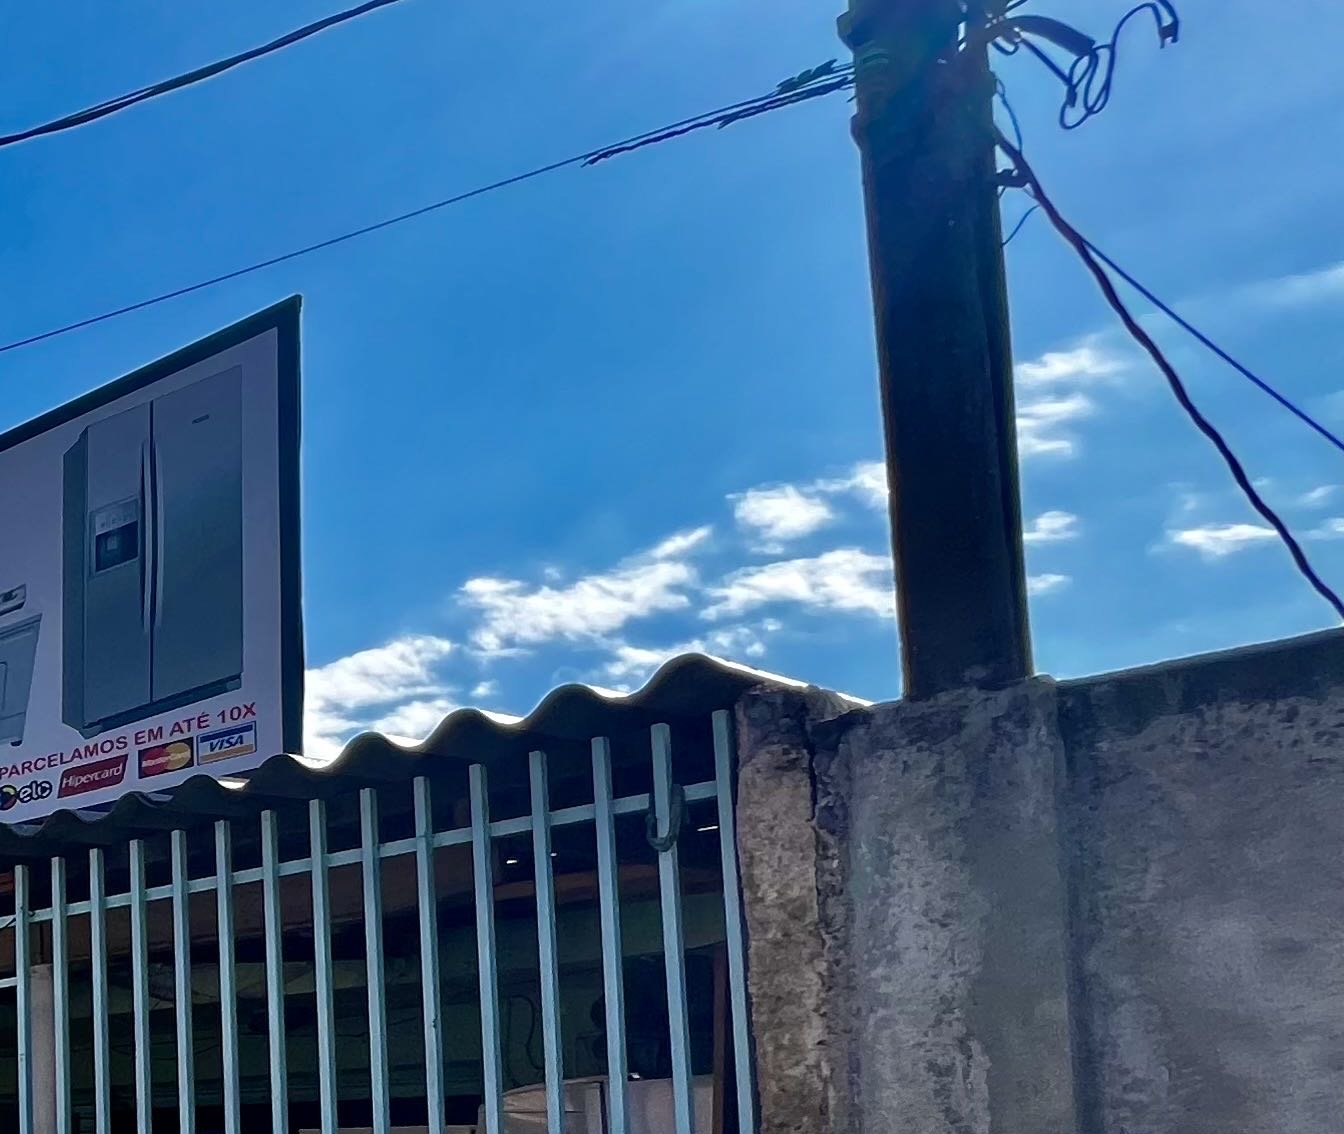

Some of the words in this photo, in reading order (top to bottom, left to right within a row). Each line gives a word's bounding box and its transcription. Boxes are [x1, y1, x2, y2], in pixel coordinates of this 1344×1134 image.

[134, 727, 163, 746] EM
[169, 712, 210, 737] ATÉ
[217, 702, 256, 724] 10X
[62, 763, 122, 788] Hipercard
[209, 734, 243, 752] VISA
